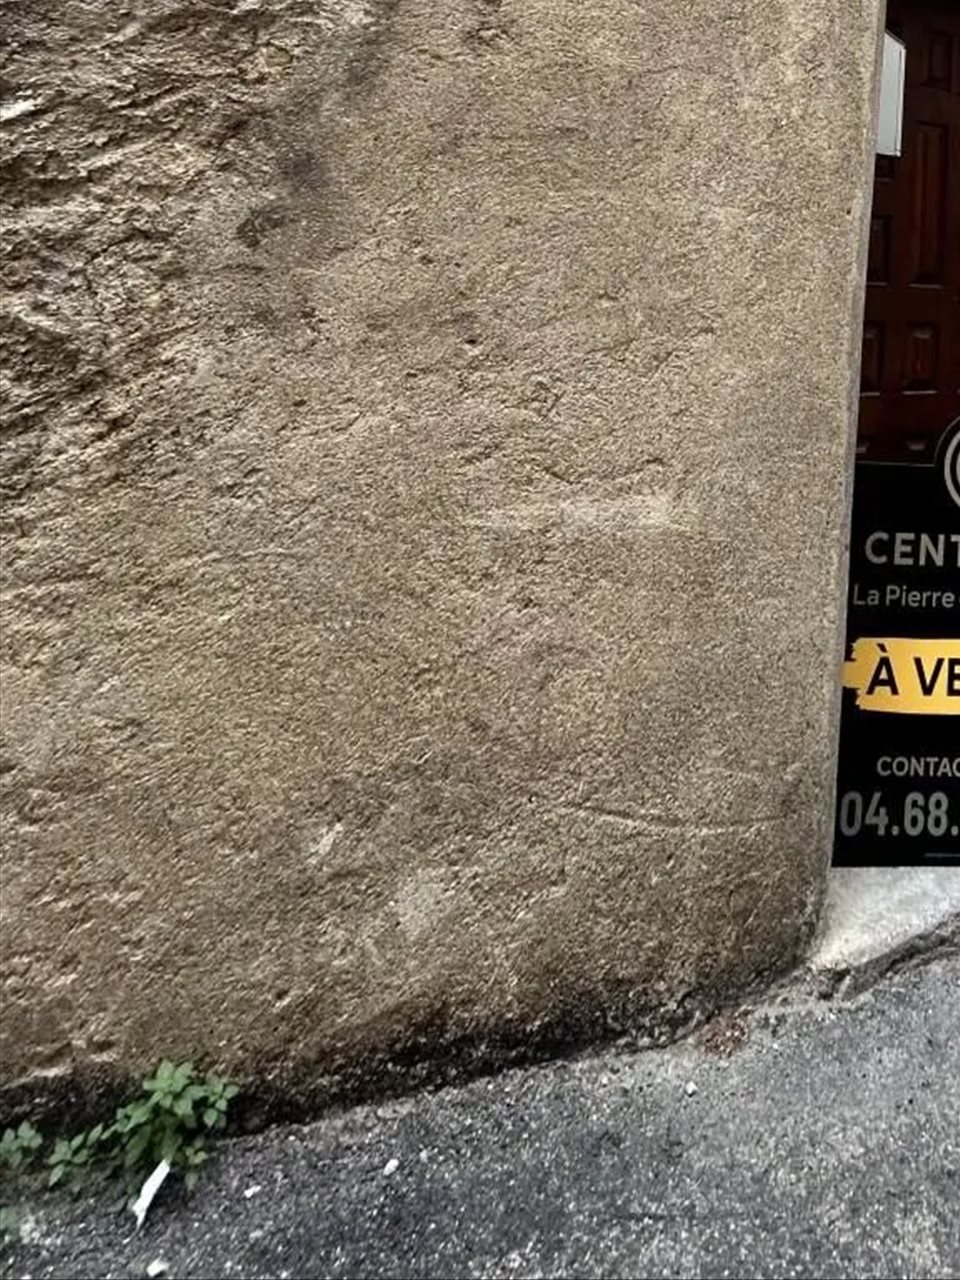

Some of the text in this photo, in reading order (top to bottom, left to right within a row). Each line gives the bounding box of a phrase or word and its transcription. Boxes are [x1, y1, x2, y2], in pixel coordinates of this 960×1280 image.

[853, 583, 880, 606] La
[885, 584, 955, 608] Pierre
[866, 643, 899, 696] À
